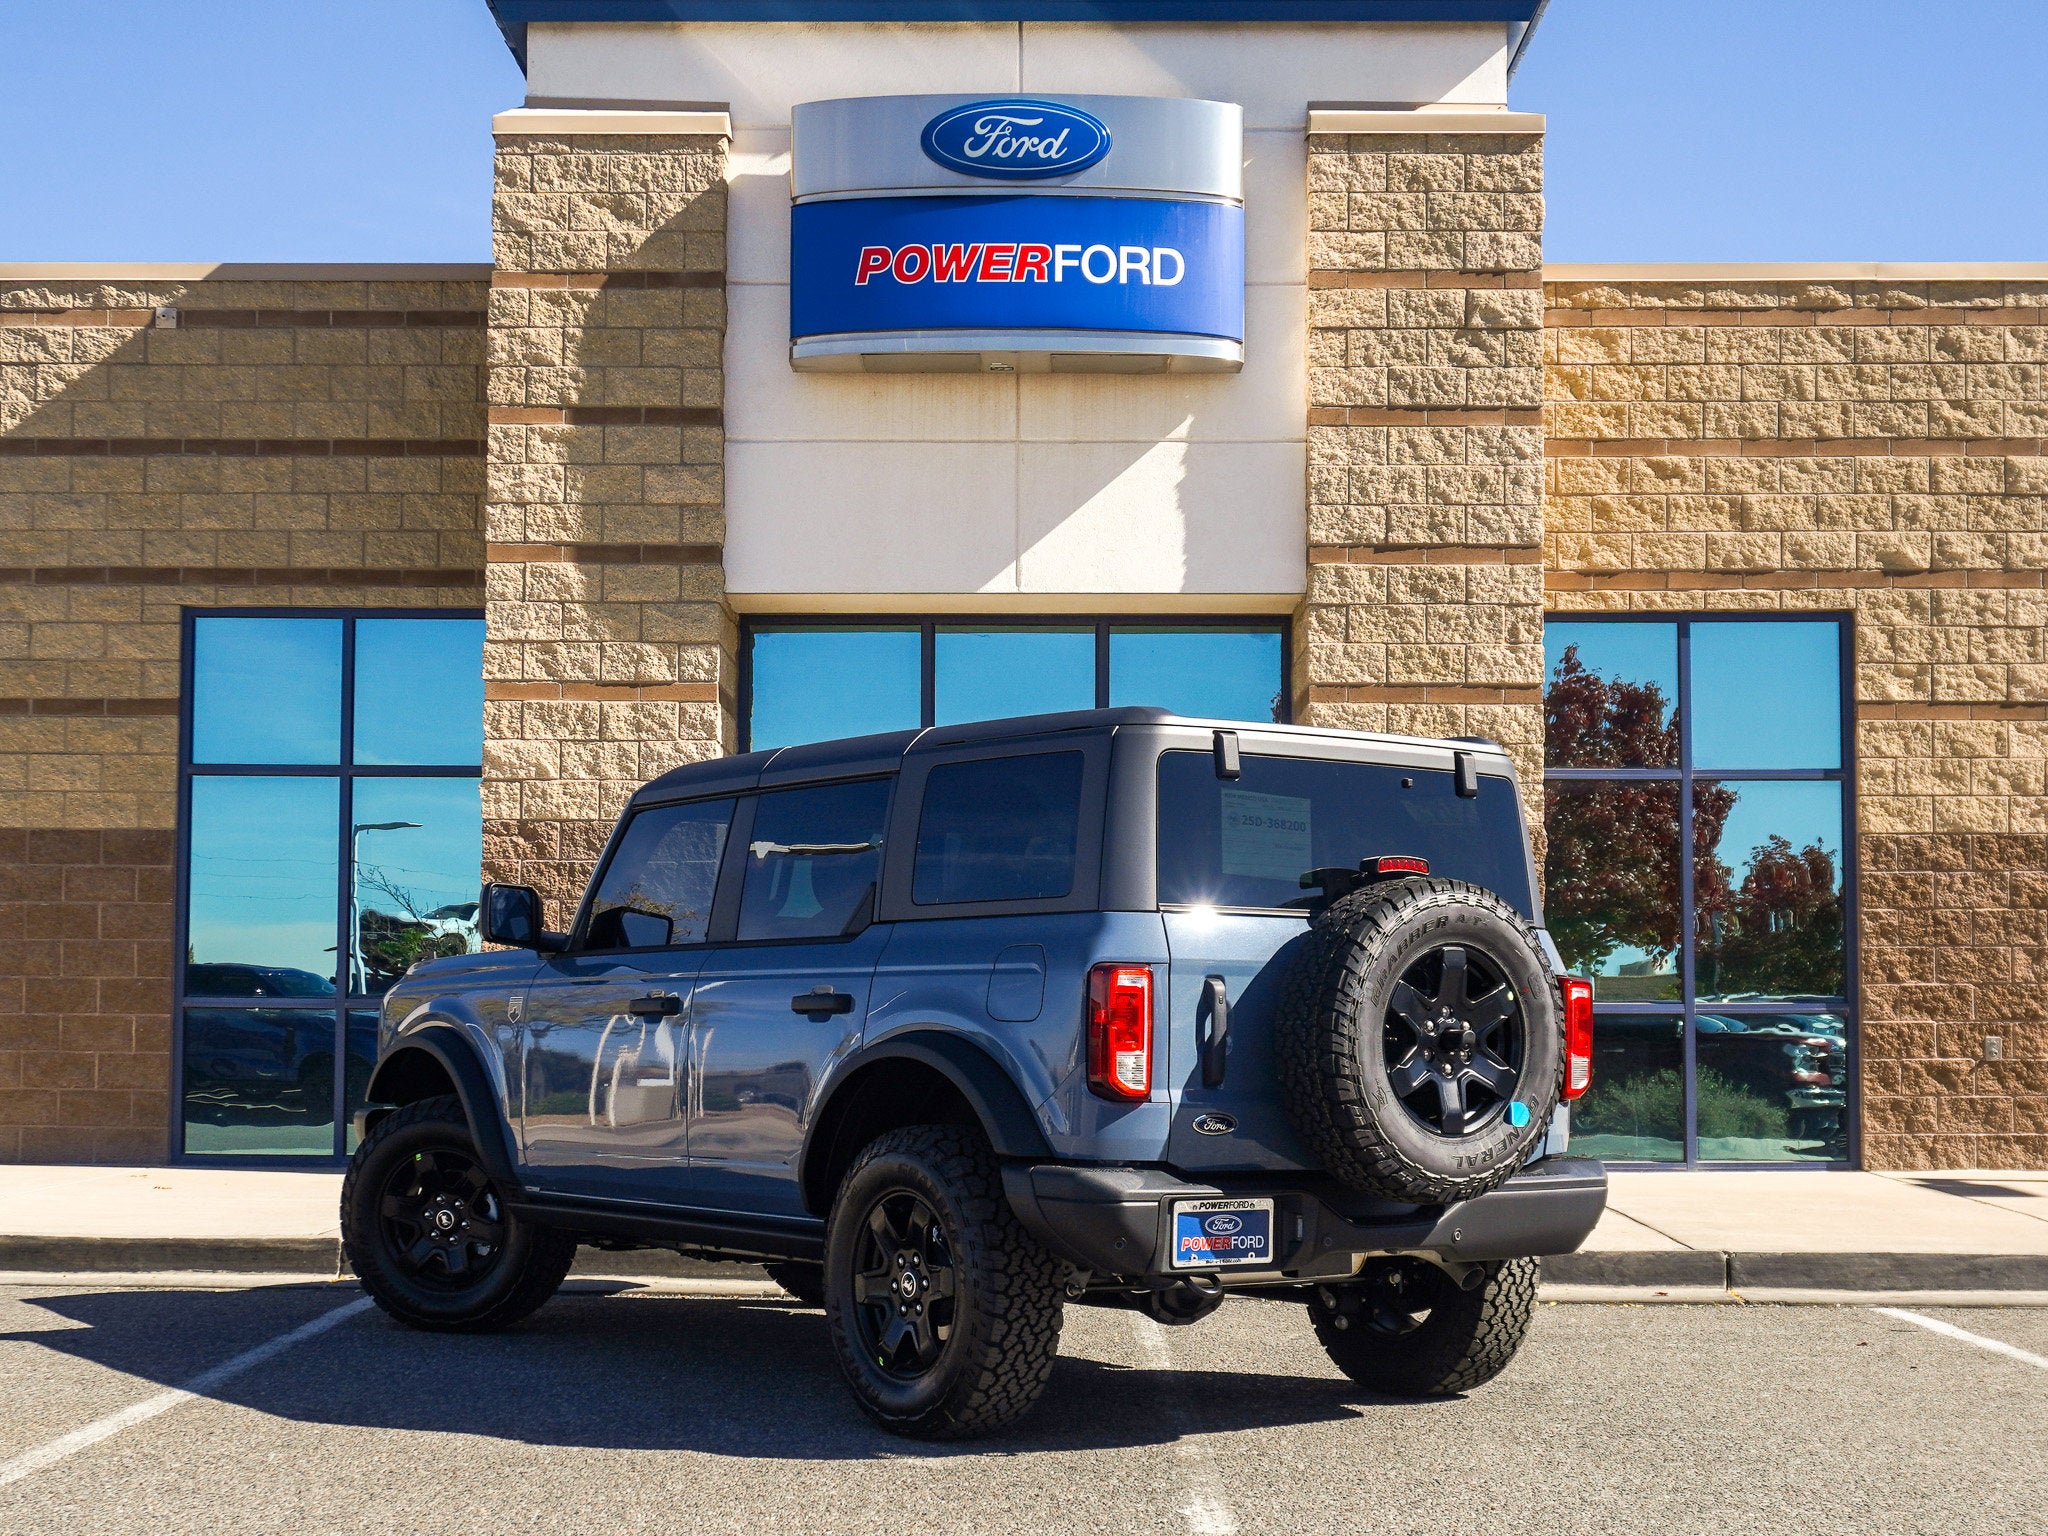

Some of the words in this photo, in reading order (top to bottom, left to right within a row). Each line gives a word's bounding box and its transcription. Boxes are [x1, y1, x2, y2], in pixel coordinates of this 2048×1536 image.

[963, 115, 1071, 160] Ford
[855, 242, 1186, 287] POWERFORD
[1203, 1117, 1228, 1130] Ford
[1451, 1093, 1540, 1170] GNERAL
[1198, 1200, 1249, 1211] POWERFORD
[1212, 1218, 1235, 1231] Ford
[1181, 1235, 1265, 1252] POWERFORD
